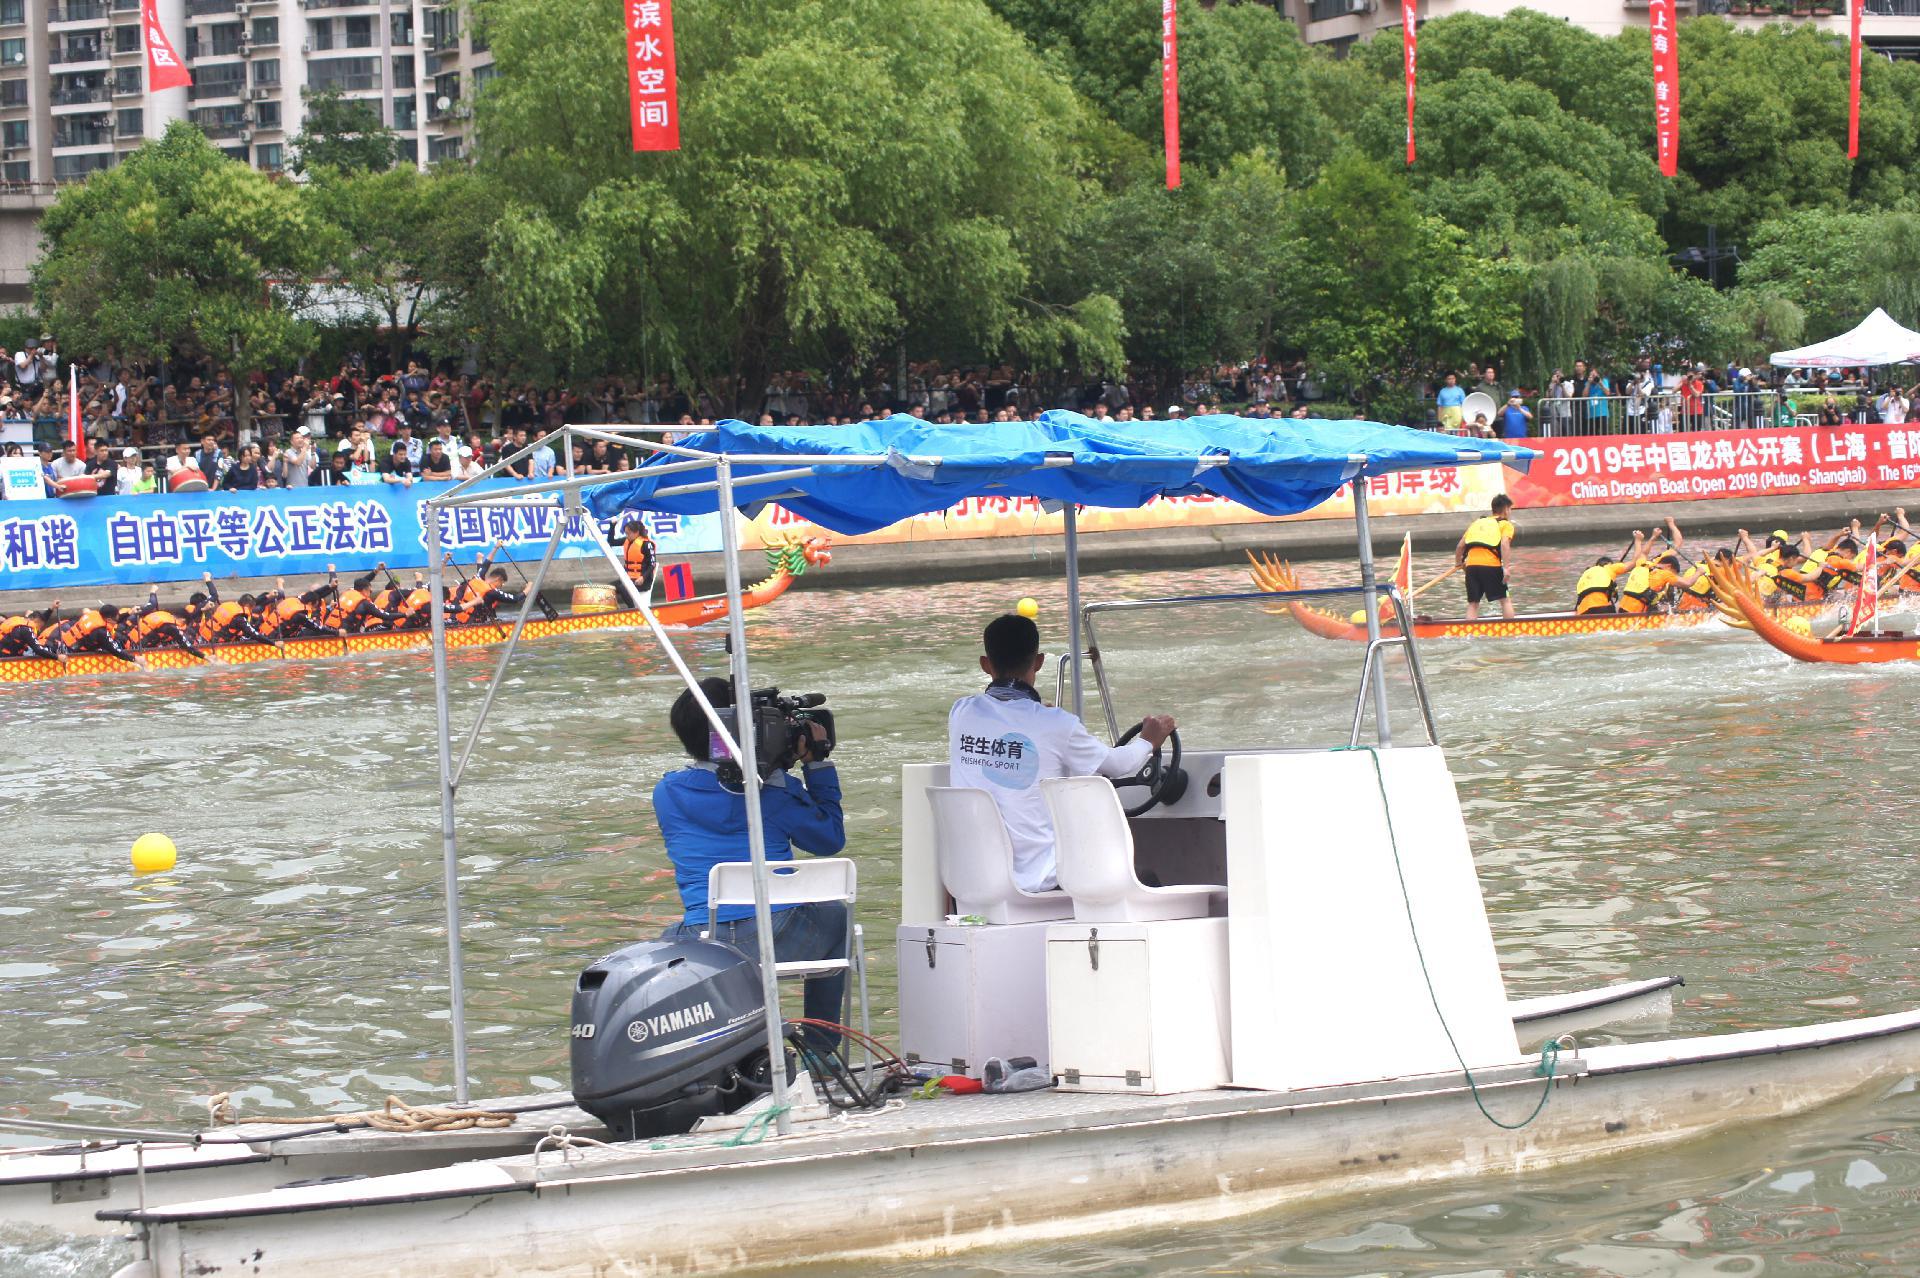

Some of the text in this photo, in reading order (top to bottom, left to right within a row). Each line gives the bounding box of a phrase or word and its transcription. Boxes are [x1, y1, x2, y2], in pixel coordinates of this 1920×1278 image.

[632, 0, 668, 128] 滨水空间
[1571, 480, 1608, 499] China
[1610, 480, 1657, 498] Dragon
[1660, 477, 1689, 494] Boat
[1691, 475, 1726, 495] Open
[1728, 472, 1758, 491] 2019
[1760, 471, 1800, 490] (Putuo
[1808, 466, 1867, 487] Shanghai)
[1878, 465, 1900, 481] The
[110, 503, 390, 563] 自由平等公正法治
[670, 563, 686, 599] 1
[959, 733, 1024, 760] 培生体育
[994, 760, 1020, 771] SPORT
[571, 1023, 596, 1038] 40
[647, 1001, 716, 1037] YAMAHA
